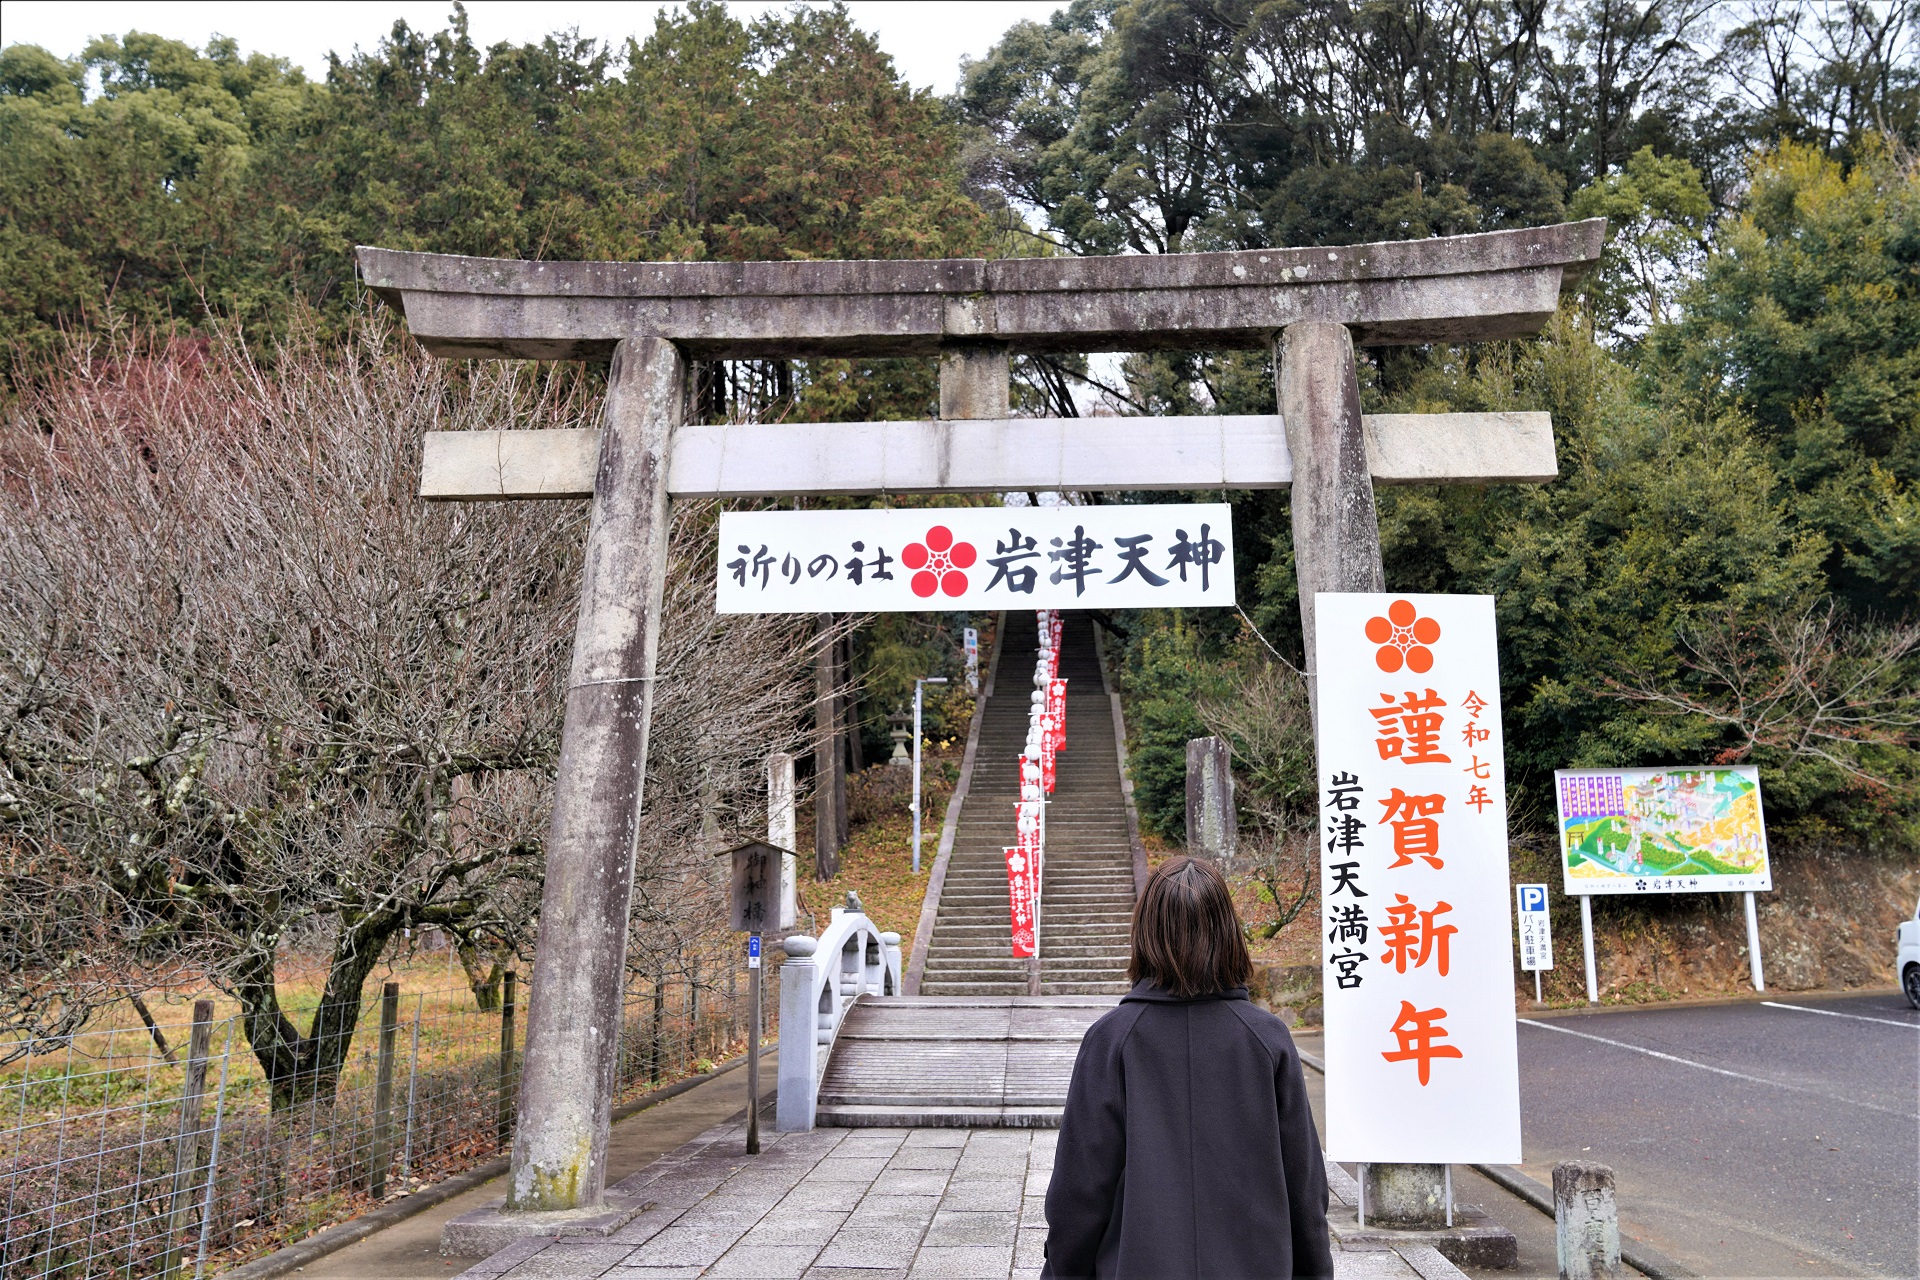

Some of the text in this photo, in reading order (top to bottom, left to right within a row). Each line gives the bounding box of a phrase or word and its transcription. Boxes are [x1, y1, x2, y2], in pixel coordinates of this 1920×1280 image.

[727, 540, 894, 592] 祈りの社
[984, 523, 1225, 598] 岩津天神
[1460, 690, 1494, 814] 令和七年
[1014, 874, 1027, 927] 岩津天神
[1325, 771, 1369, 990] 岩津天満宮
[1368, 688, 1464, 1086] 謹賀新年
[1524, 888, 1542, 911] P
[1653, 878, 1698, 890] 岩津天神
[1524, 914, 1536, 966] バス駐車場
[1538, 919, 1547, 960] 岩津天満宮
